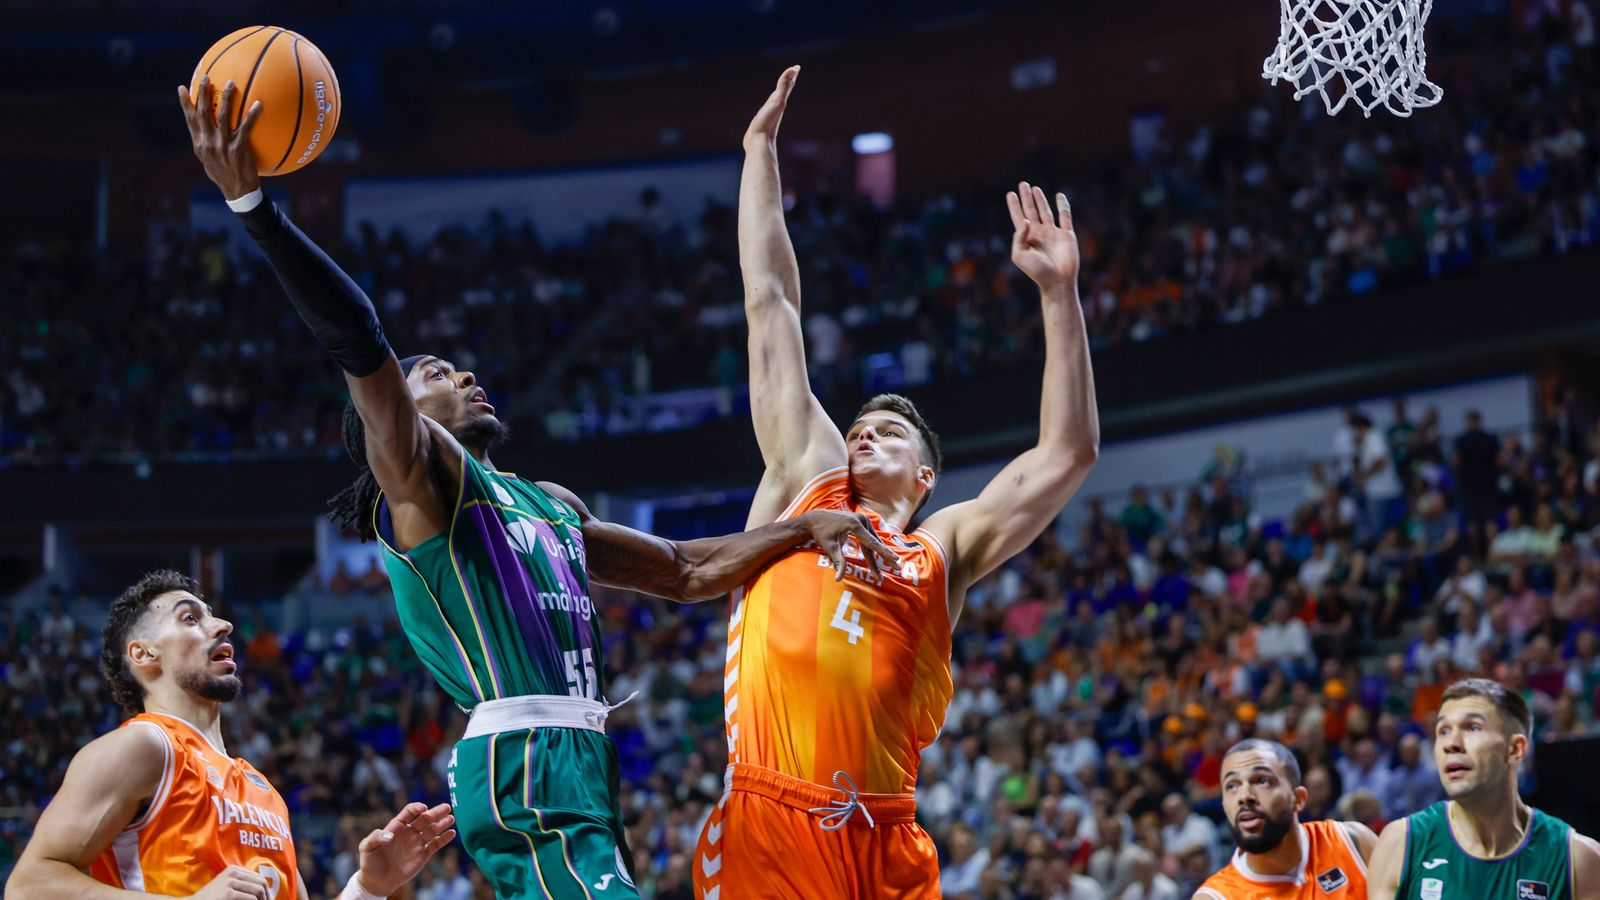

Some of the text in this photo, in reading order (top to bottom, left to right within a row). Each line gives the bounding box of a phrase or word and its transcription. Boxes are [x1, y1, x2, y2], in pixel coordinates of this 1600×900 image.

[816, 554, 884, 588] BSKE
[829, 590, 865, 646] 4
[563, 647, 598, 699] 55
[210, 794, 290, 840] VALENCIA
[239, 829, 285, 852] BASKET
